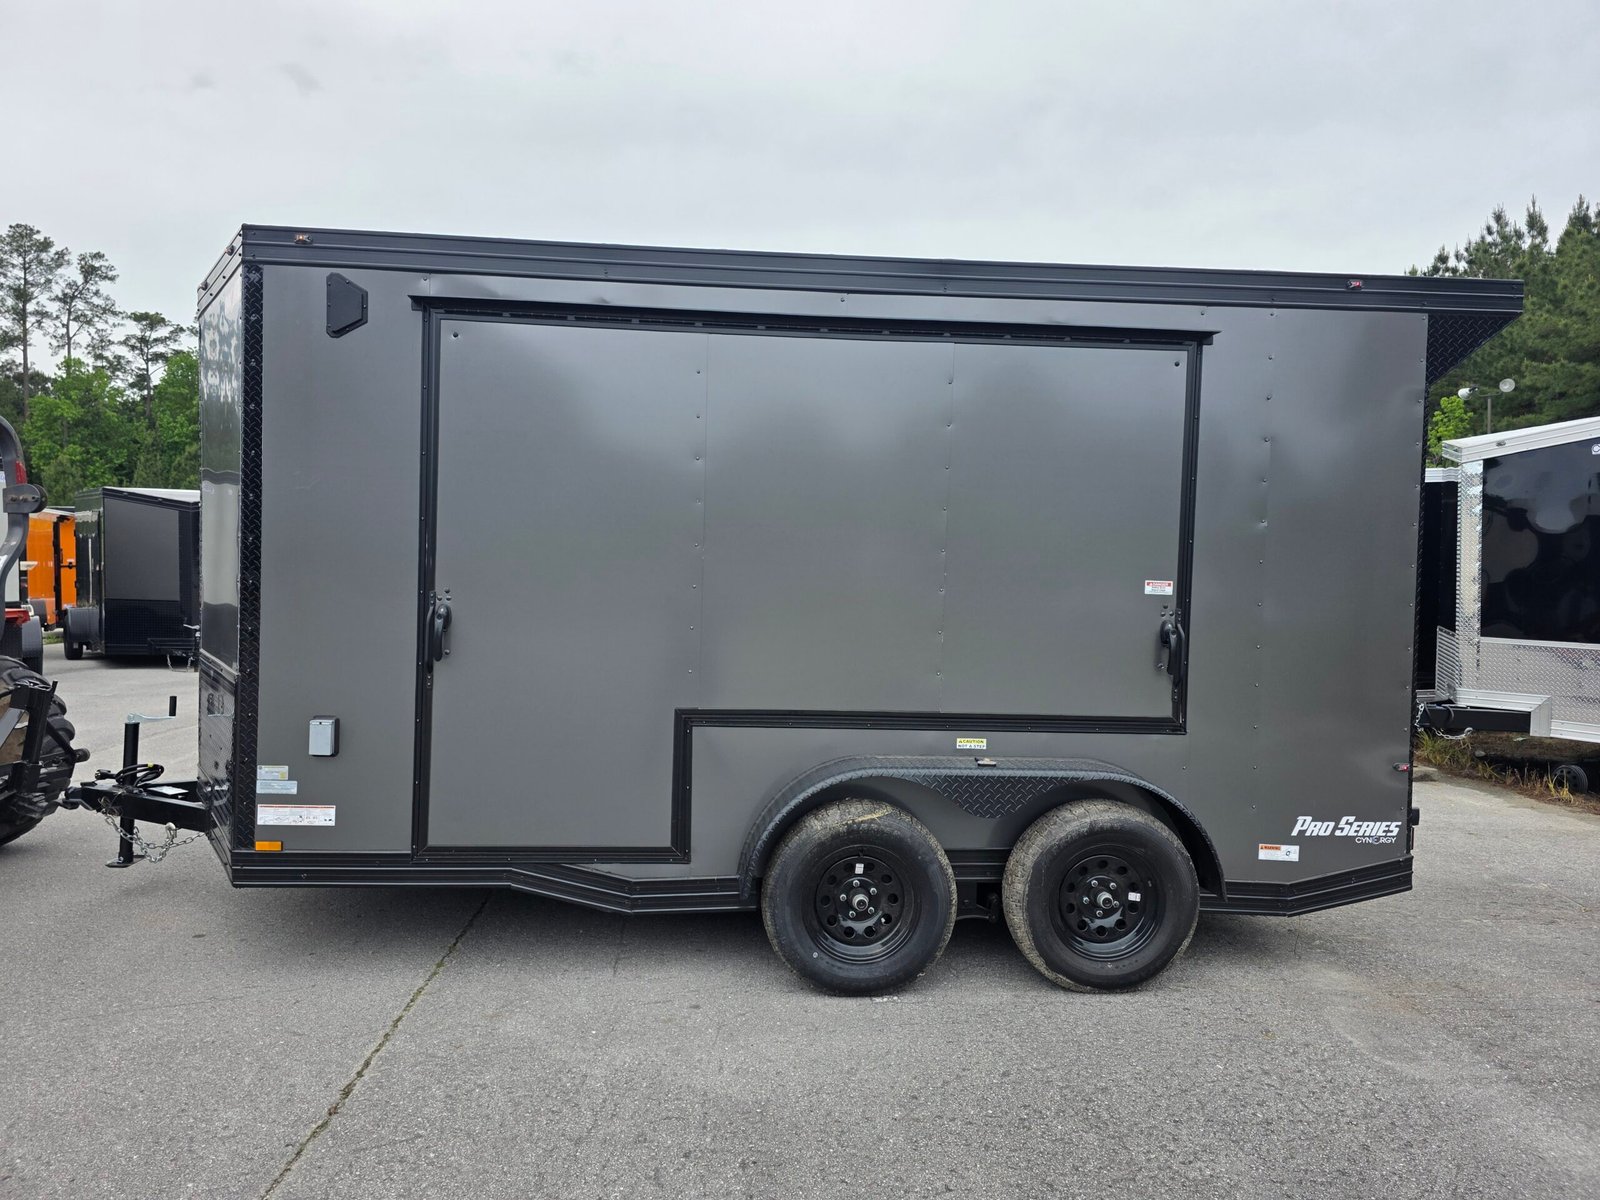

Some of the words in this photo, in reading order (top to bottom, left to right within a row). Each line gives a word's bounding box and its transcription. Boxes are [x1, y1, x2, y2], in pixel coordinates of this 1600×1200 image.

[1291, 816, 1335, 836] PRO
[1335, 816, 1402, 836] SERIES
[1355, 836, 1397, 844] CYNERGY
